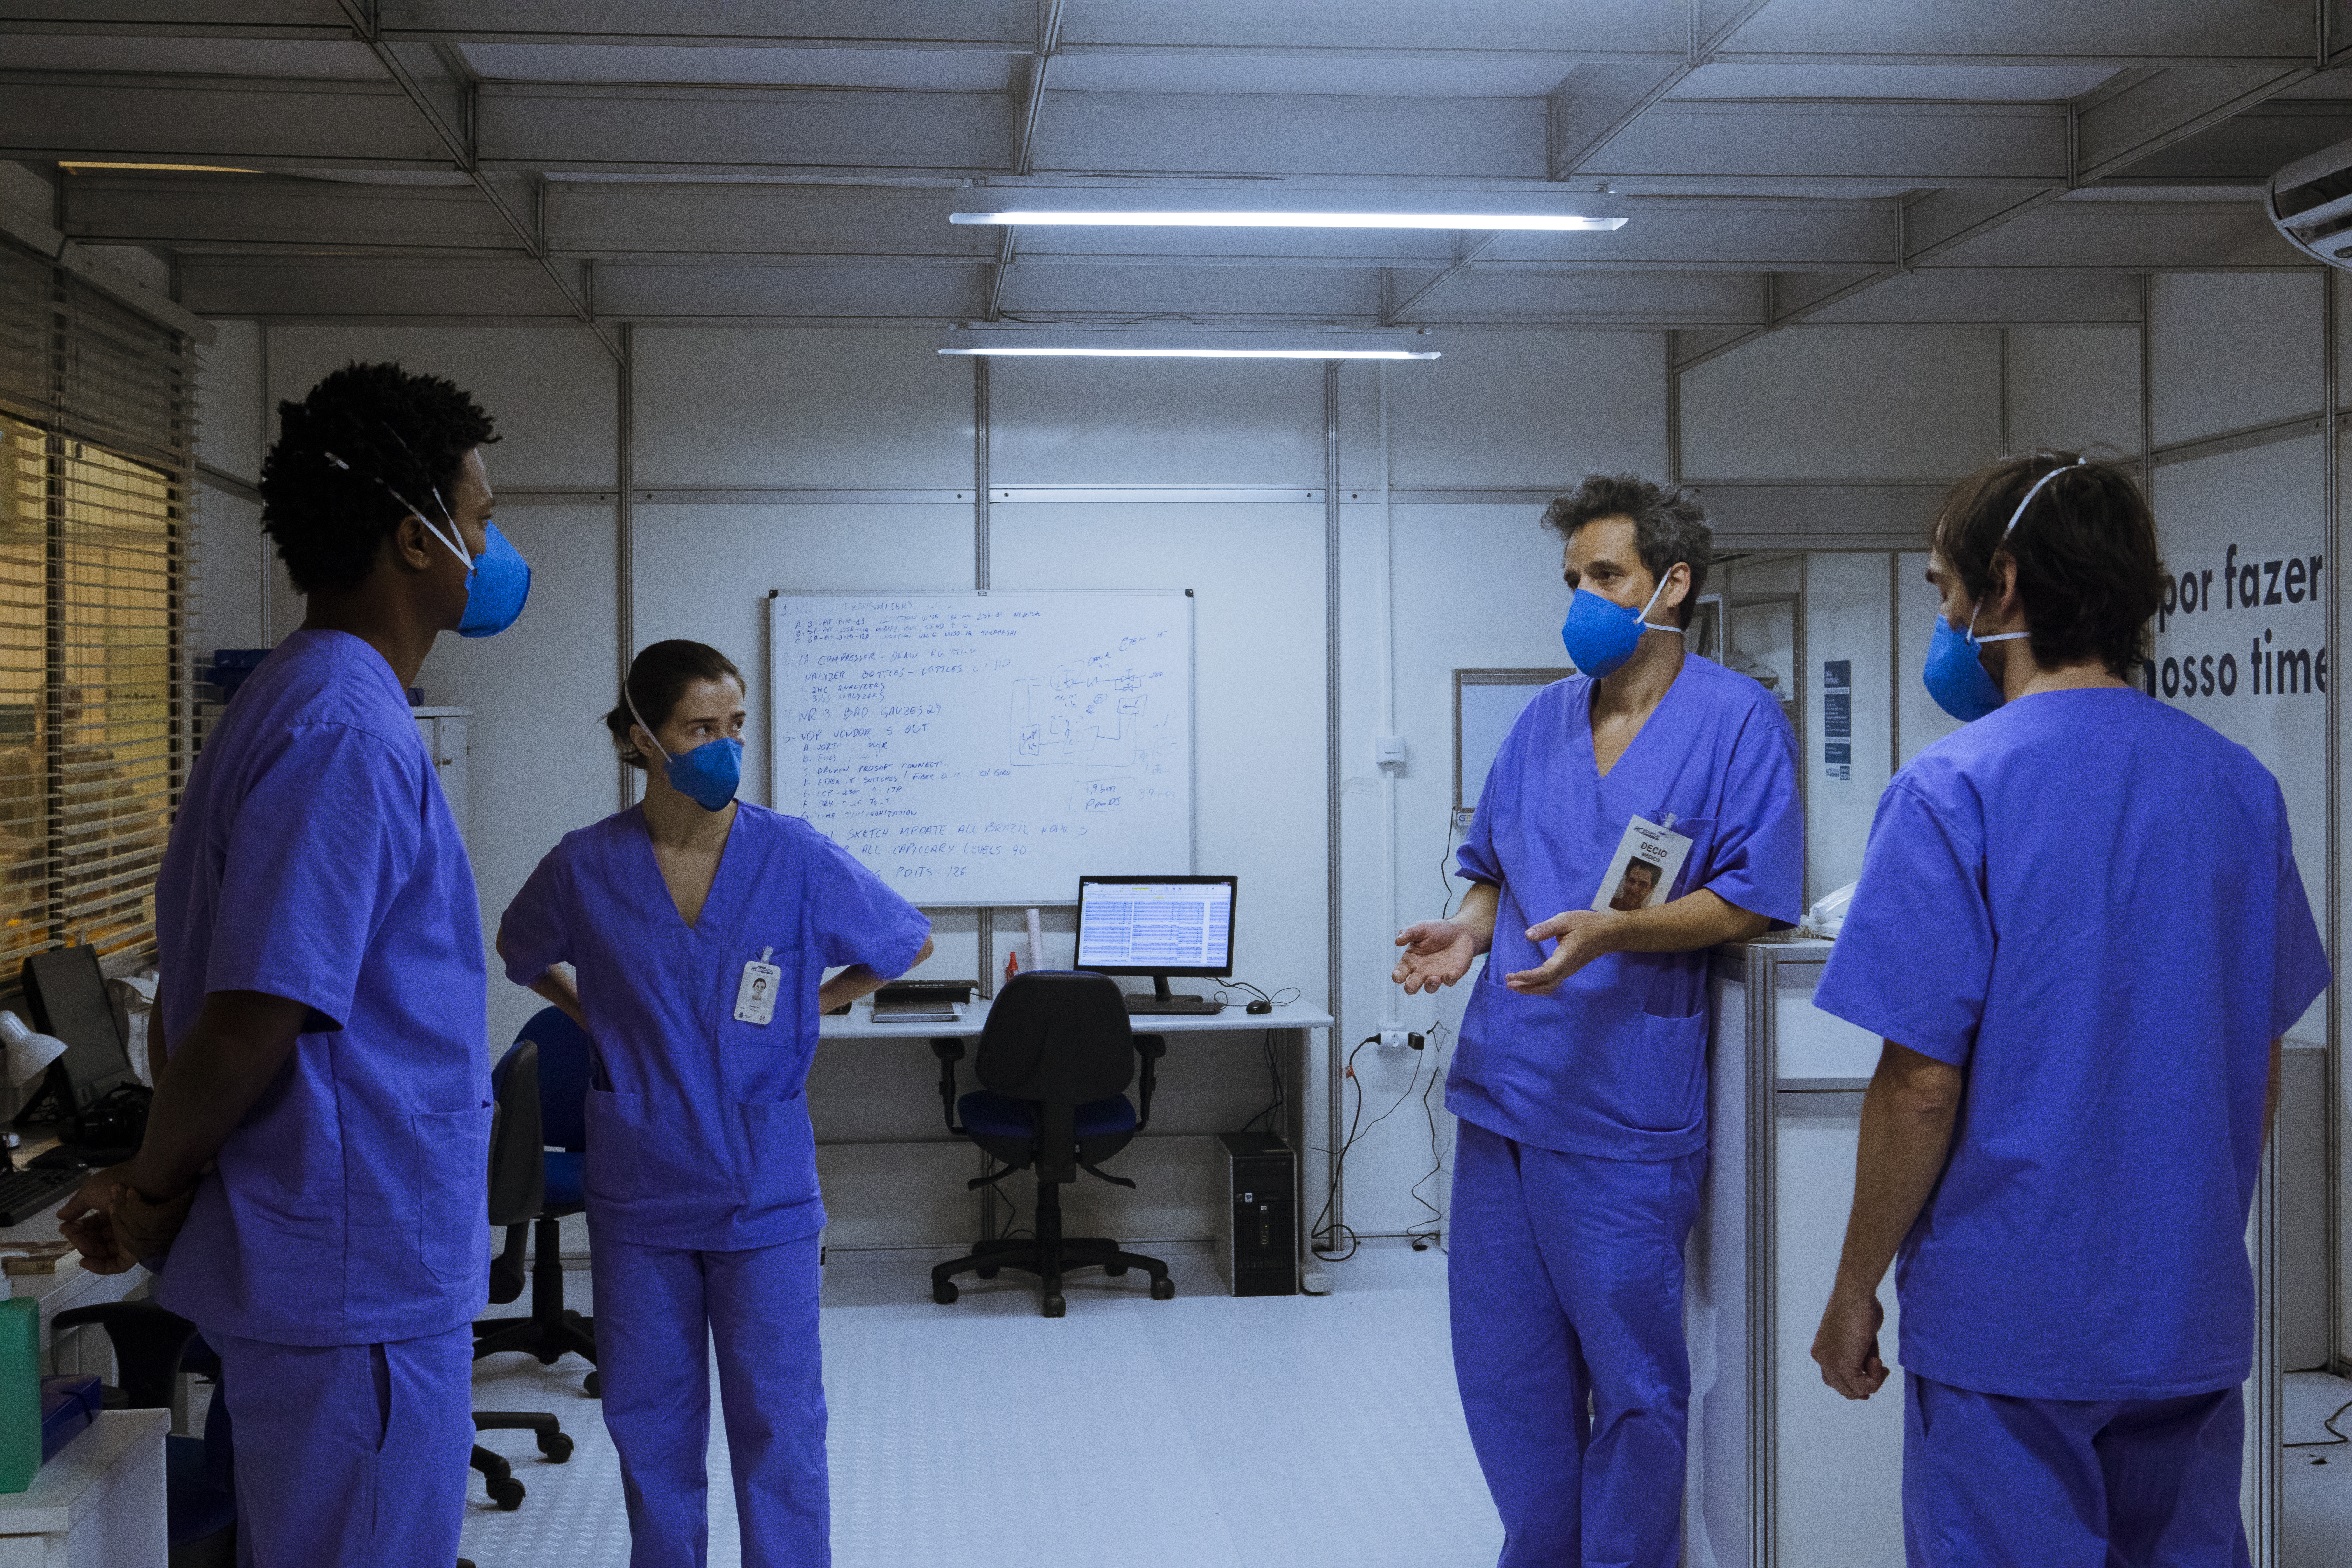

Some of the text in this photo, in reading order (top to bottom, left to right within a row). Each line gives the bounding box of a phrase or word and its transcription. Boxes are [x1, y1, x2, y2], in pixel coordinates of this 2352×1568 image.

[2159, 543, 2323, 633] por fazer
[1641, 841, 1668, 858] DECIO
